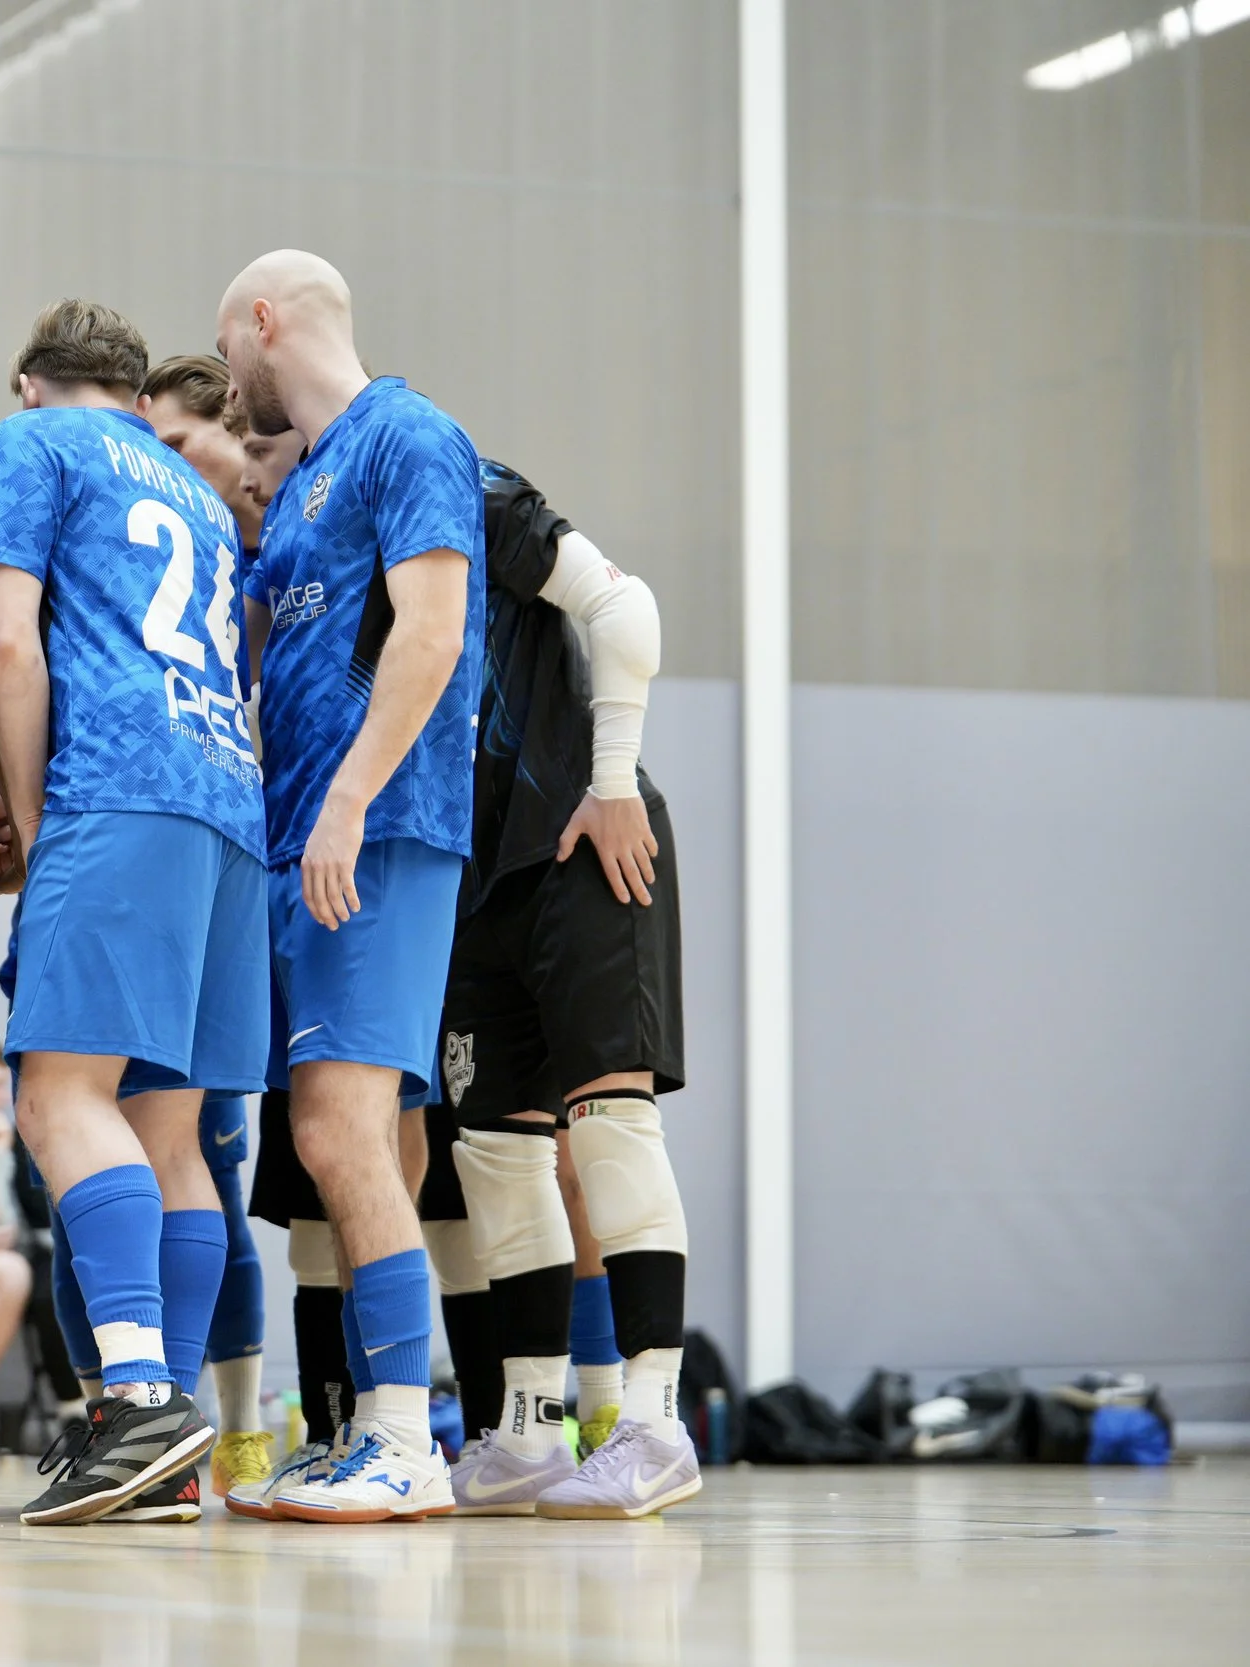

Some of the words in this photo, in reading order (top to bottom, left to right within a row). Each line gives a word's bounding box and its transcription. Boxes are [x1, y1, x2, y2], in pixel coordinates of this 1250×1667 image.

[102, 434, 195, 512] POMPEY
[275, 603, 327, 630] GROUP
[170, 720, 215, 751] PRIME
